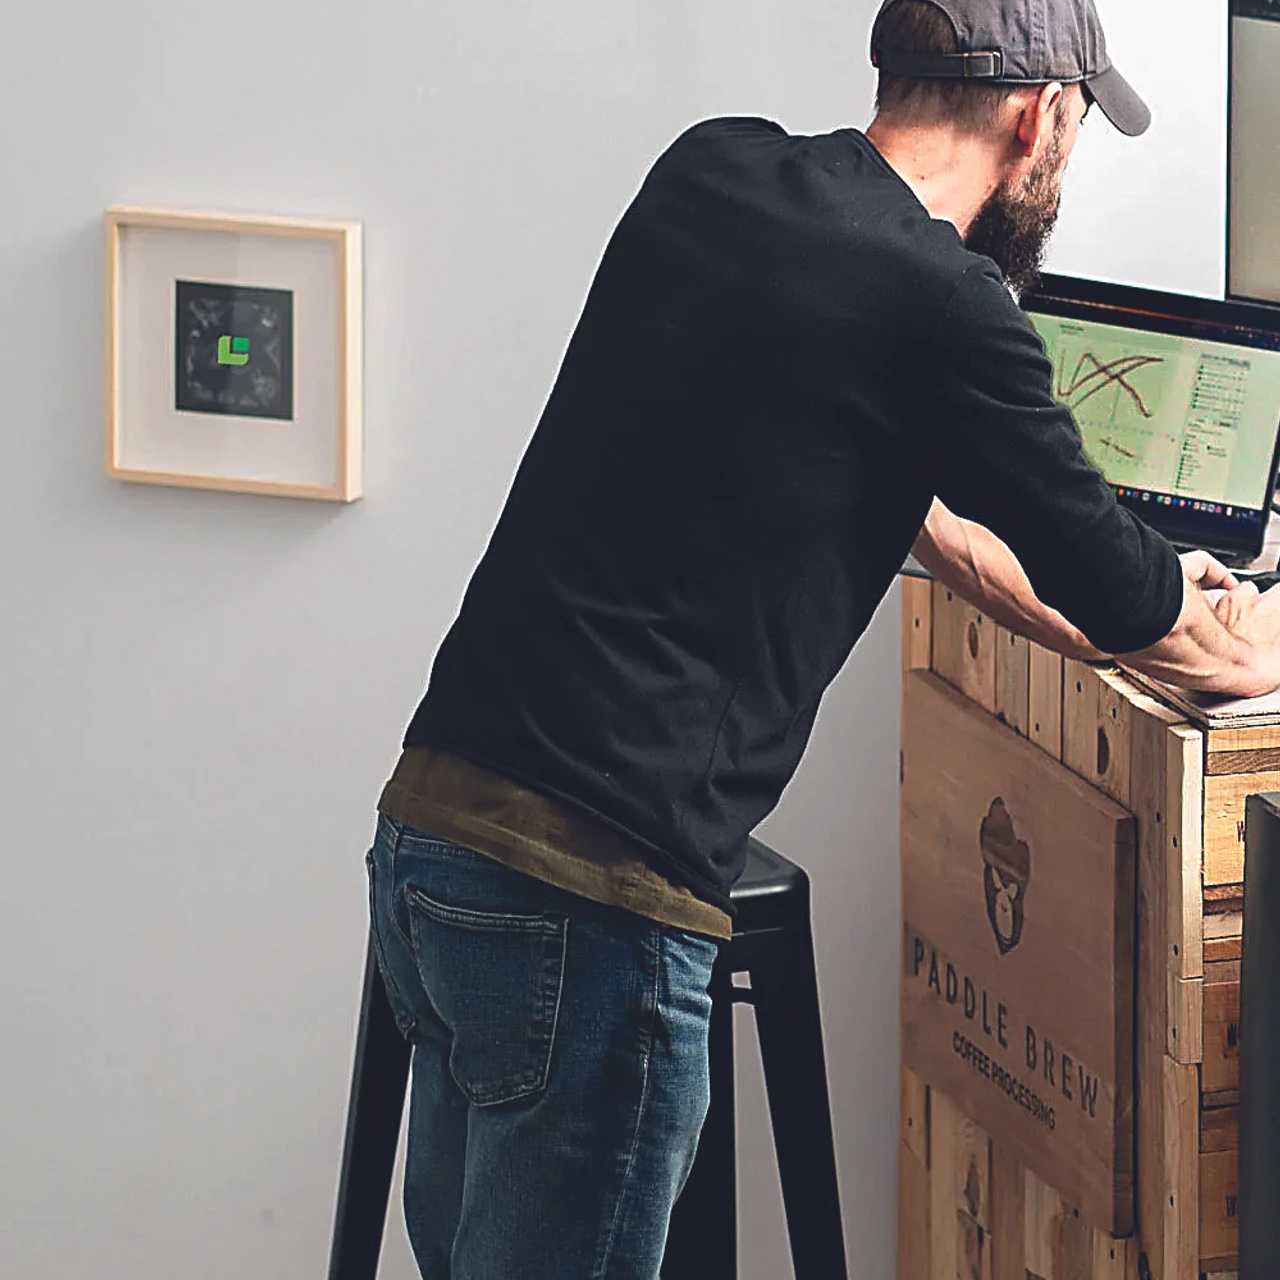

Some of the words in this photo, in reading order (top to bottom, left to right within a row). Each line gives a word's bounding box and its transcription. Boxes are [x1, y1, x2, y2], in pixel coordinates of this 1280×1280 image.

[913, 937, 1008, 1049] PADDLE
[1026, 1025, 1098, 1117] BREW
[953, 1031, 990, 1079] COFFEE
